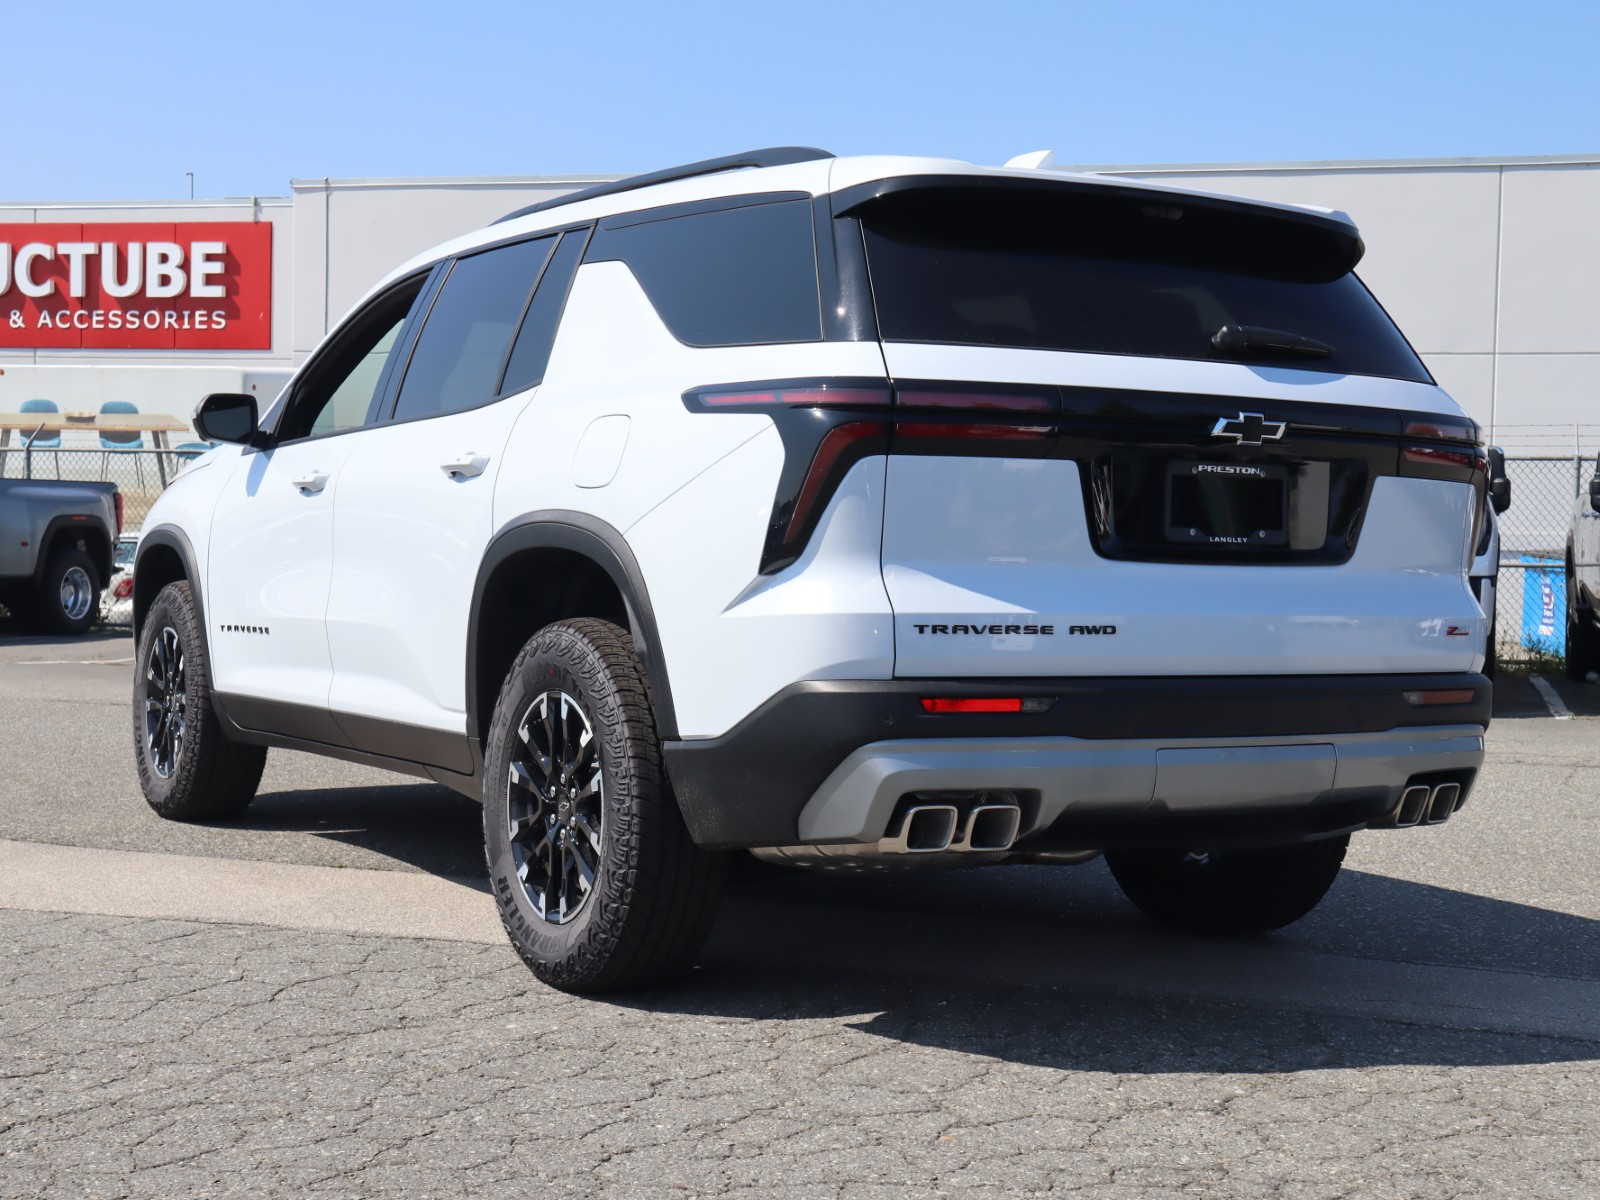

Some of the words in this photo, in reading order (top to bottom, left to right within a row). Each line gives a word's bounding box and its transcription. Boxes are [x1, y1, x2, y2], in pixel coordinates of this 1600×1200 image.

[0, 241, 227, 298] CTUBE
[9, 310, 26, 329] &
[37, 310, 227, 330] ACCESSORIES
[1197, 464, 1261, 476] PRESTON
[1209, 536, 1248, 544] LANGLEY
[219, 625, 270, 636] TRAVERSE
[913, 624, 1054, 635] TRAVERSE
[1069, 625, 1117, 636] AWD
[497, 875, 562, 955] WRANGLER
